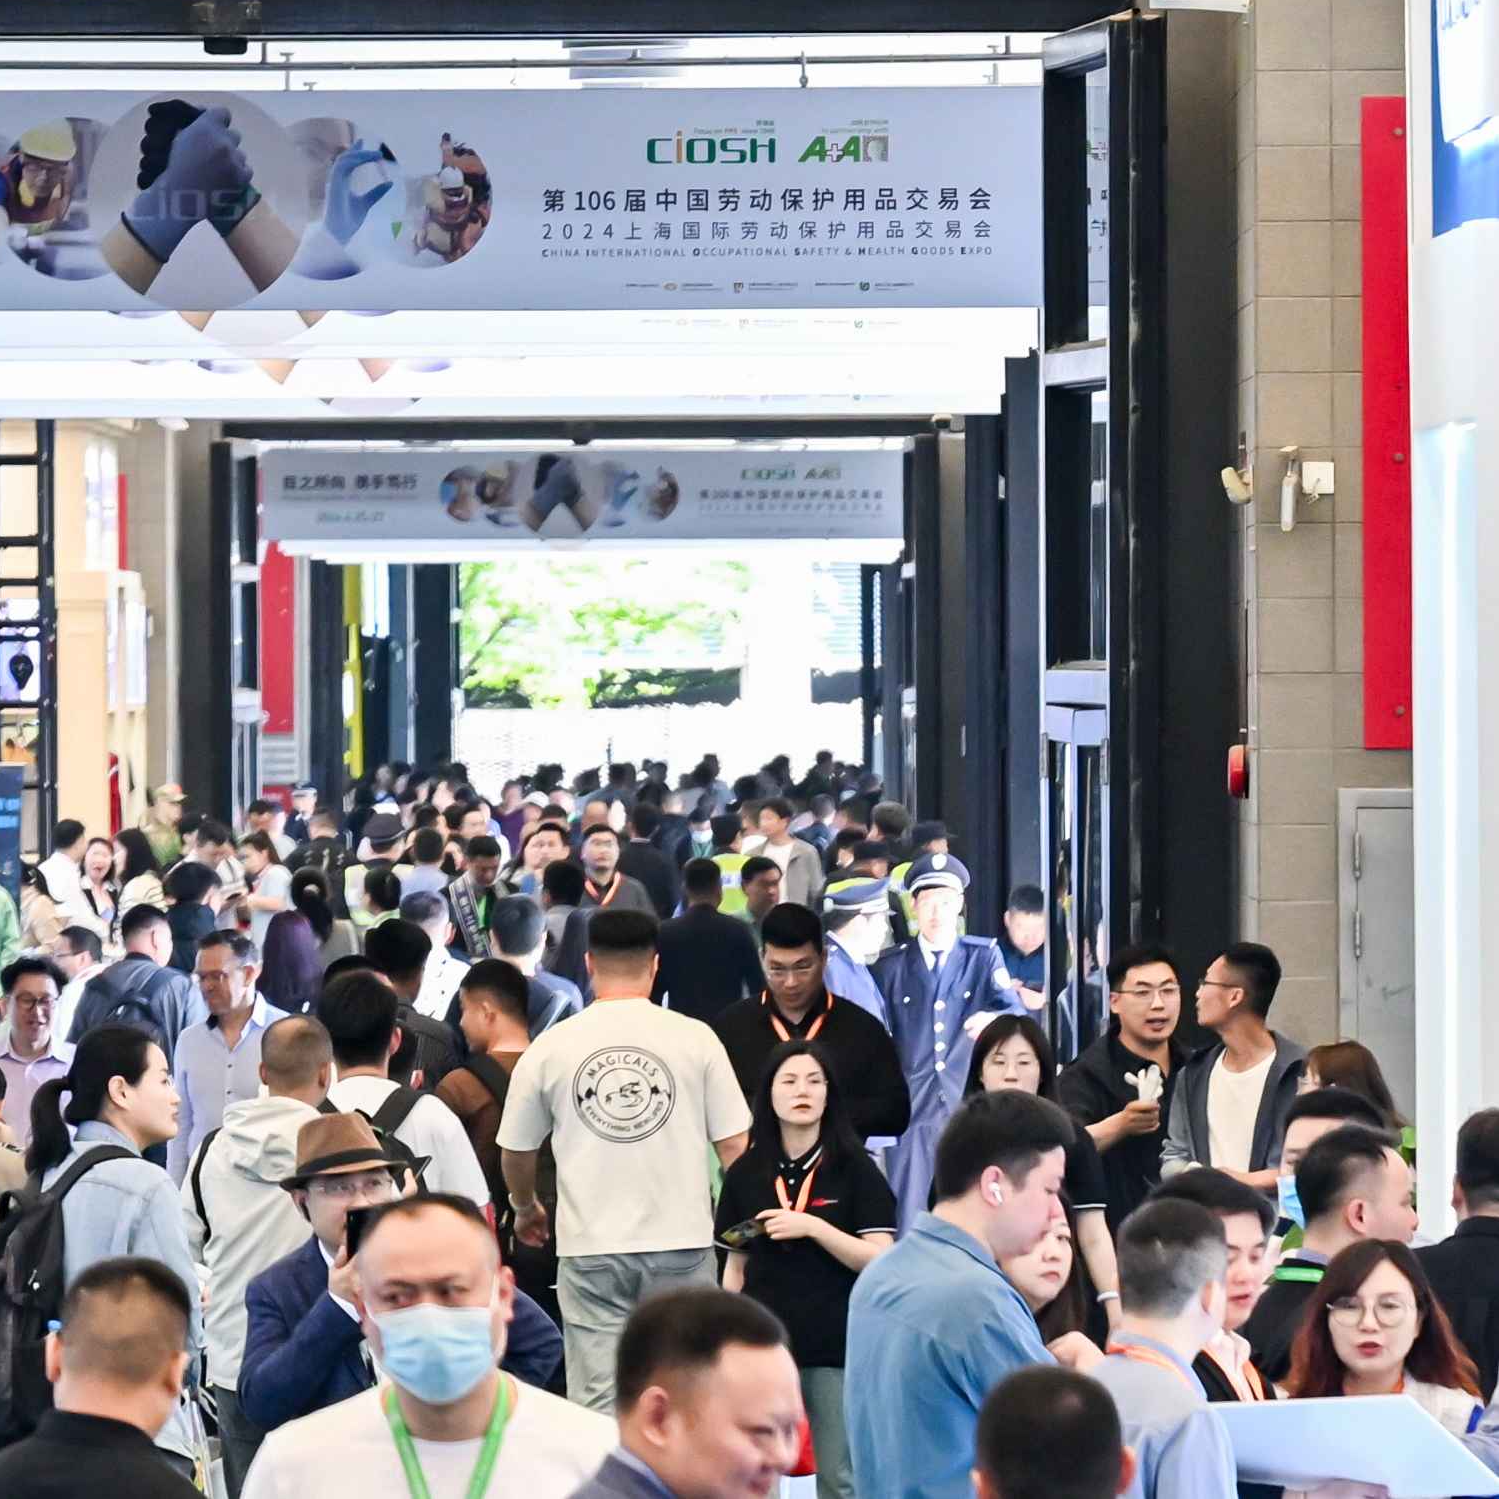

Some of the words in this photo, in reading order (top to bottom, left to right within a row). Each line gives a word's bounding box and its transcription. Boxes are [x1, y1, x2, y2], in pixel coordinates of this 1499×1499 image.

[542, 187, 992, 213] 第106届中国劳动保护用品交易会
[542, 248, 580, 258] CHINA
[586, 248, 686, 258] INTERNATIONAL
[692, 247, 788, 258] OCCUPATIONAL
[793, 246, 839, 257] SAFETY
[858, 246, 905, 256] HEALTH
[911, 246, 954, 256] GOODS
[960, 245, 993, 256] EXPO
[585, 1053, 659, 1080] MAGICALS
